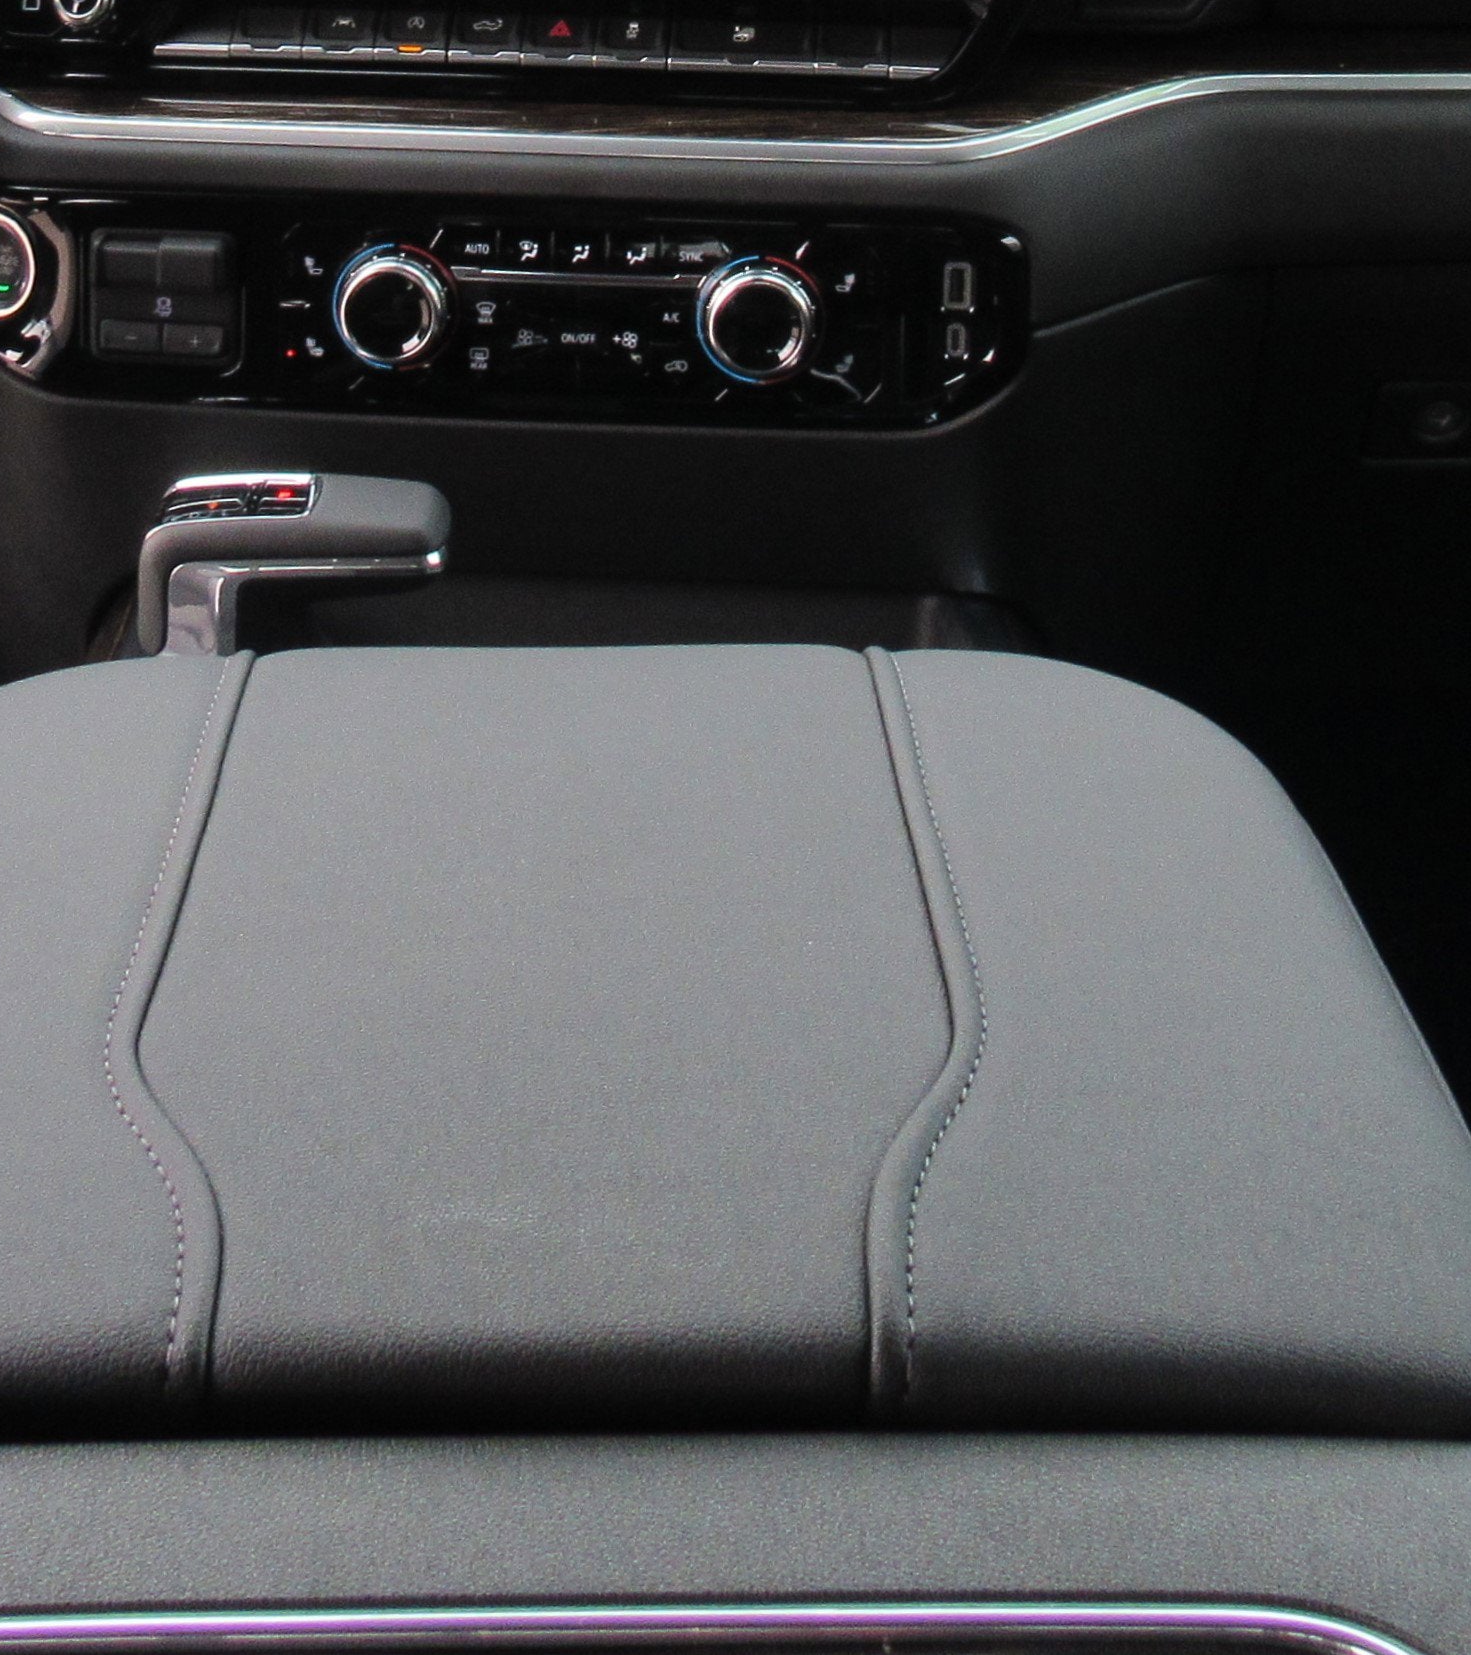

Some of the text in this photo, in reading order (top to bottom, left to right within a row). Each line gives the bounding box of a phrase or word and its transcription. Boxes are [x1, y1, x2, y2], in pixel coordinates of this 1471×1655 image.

[464, 243, 490, 255] AUTO
[678, 251, 704, 263] SYNC
[662, 311, 680, 323] A/C
[560, 332, 597, 344] ON/OFF
